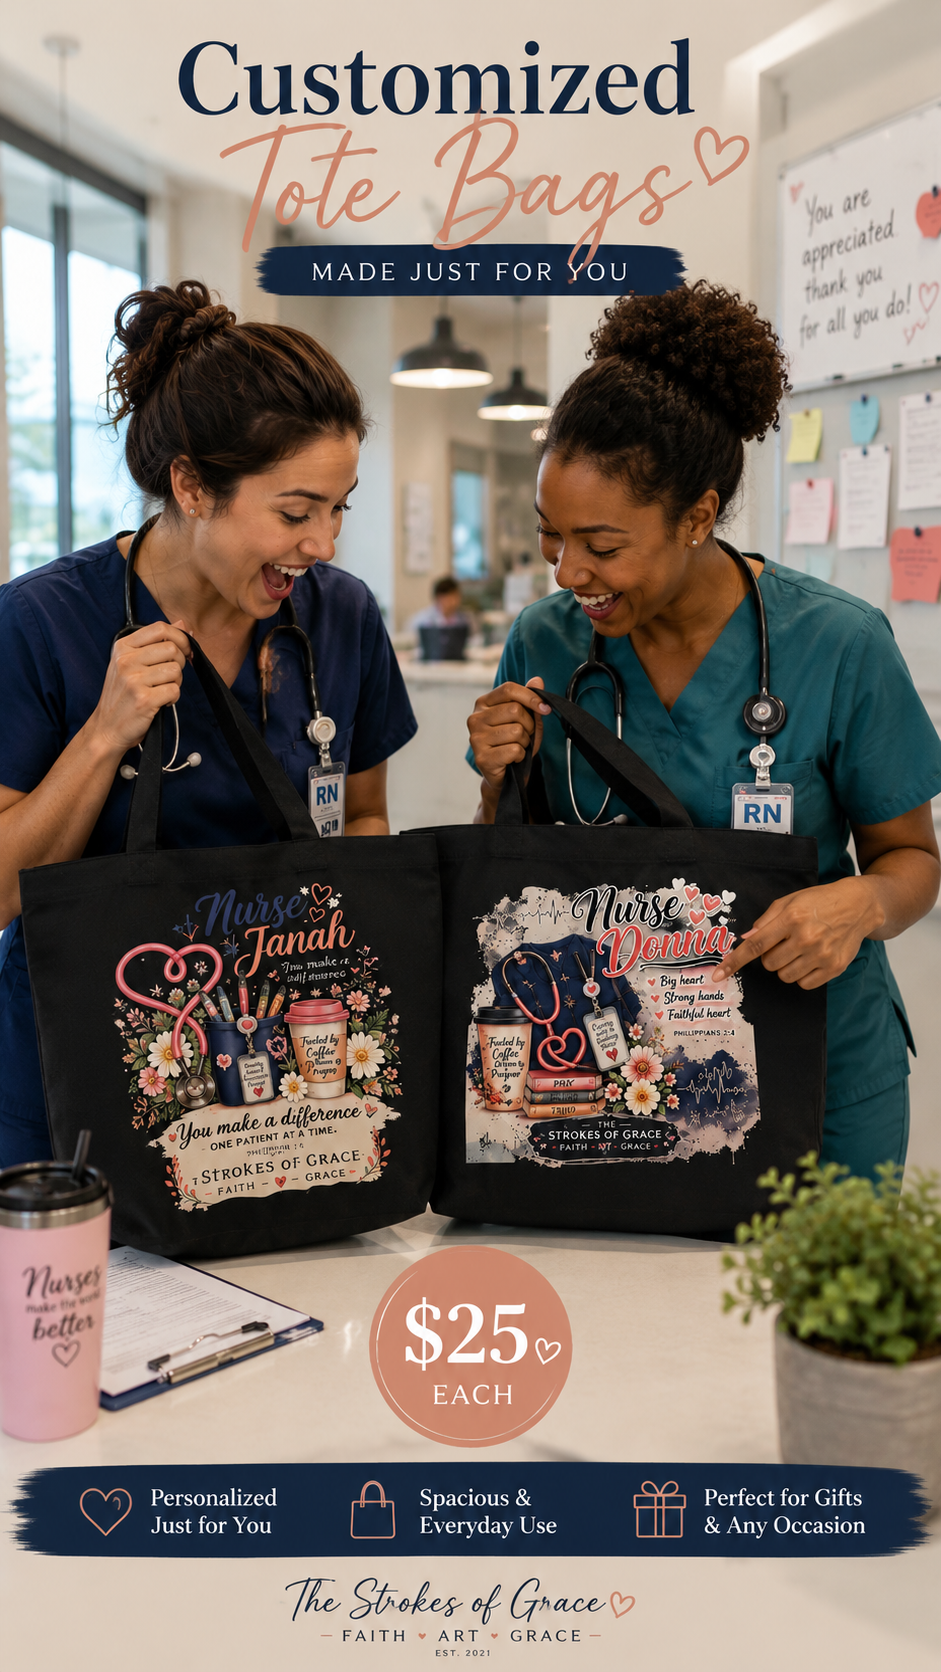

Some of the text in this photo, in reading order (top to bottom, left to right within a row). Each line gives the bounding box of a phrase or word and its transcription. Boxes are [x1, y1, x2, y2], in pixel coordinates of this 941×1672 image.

[805, 188, 872, 238] You are
[802, 208, 895, 273] appreciated
[805, 265, 883, 304] thank you
[800, 283, 912, 348] for all you do!
[316, 783, 338, 806] RN
[744, 803, 782, 823] RN
[195, 889, 308, 937] Nurse
[571, 885, 684, 933] Nurse
[234, 909, 356, 978] Janah
[597, 925, 735, 978] Donna
[660, 974, 704, 989] Big heart
[664, 990, 724, 1005] Strong hands
[667, 1008, 704, 1022] Faithful
[176, 1105, 363, 1150] You make a difference
[210, 1126, 337, 1151] ONE PATIENT AT A TIME.
[548, 1130, 662, 1140] STROKES OF GRACE
[281, 1157, 300, 1170] OF
[306, 1149, 361, 1167] GRACE
[559, 1143, 588, 1151] FAITH
[620, 1142, 651, 1150] GRACE
[217, 1168, 346, 1196] FAITH GRACE
[22, 1264, 102, 1299] Nurses
[26, 1302, 57, 1313] make
[32, 1313, 95, 1341] better
